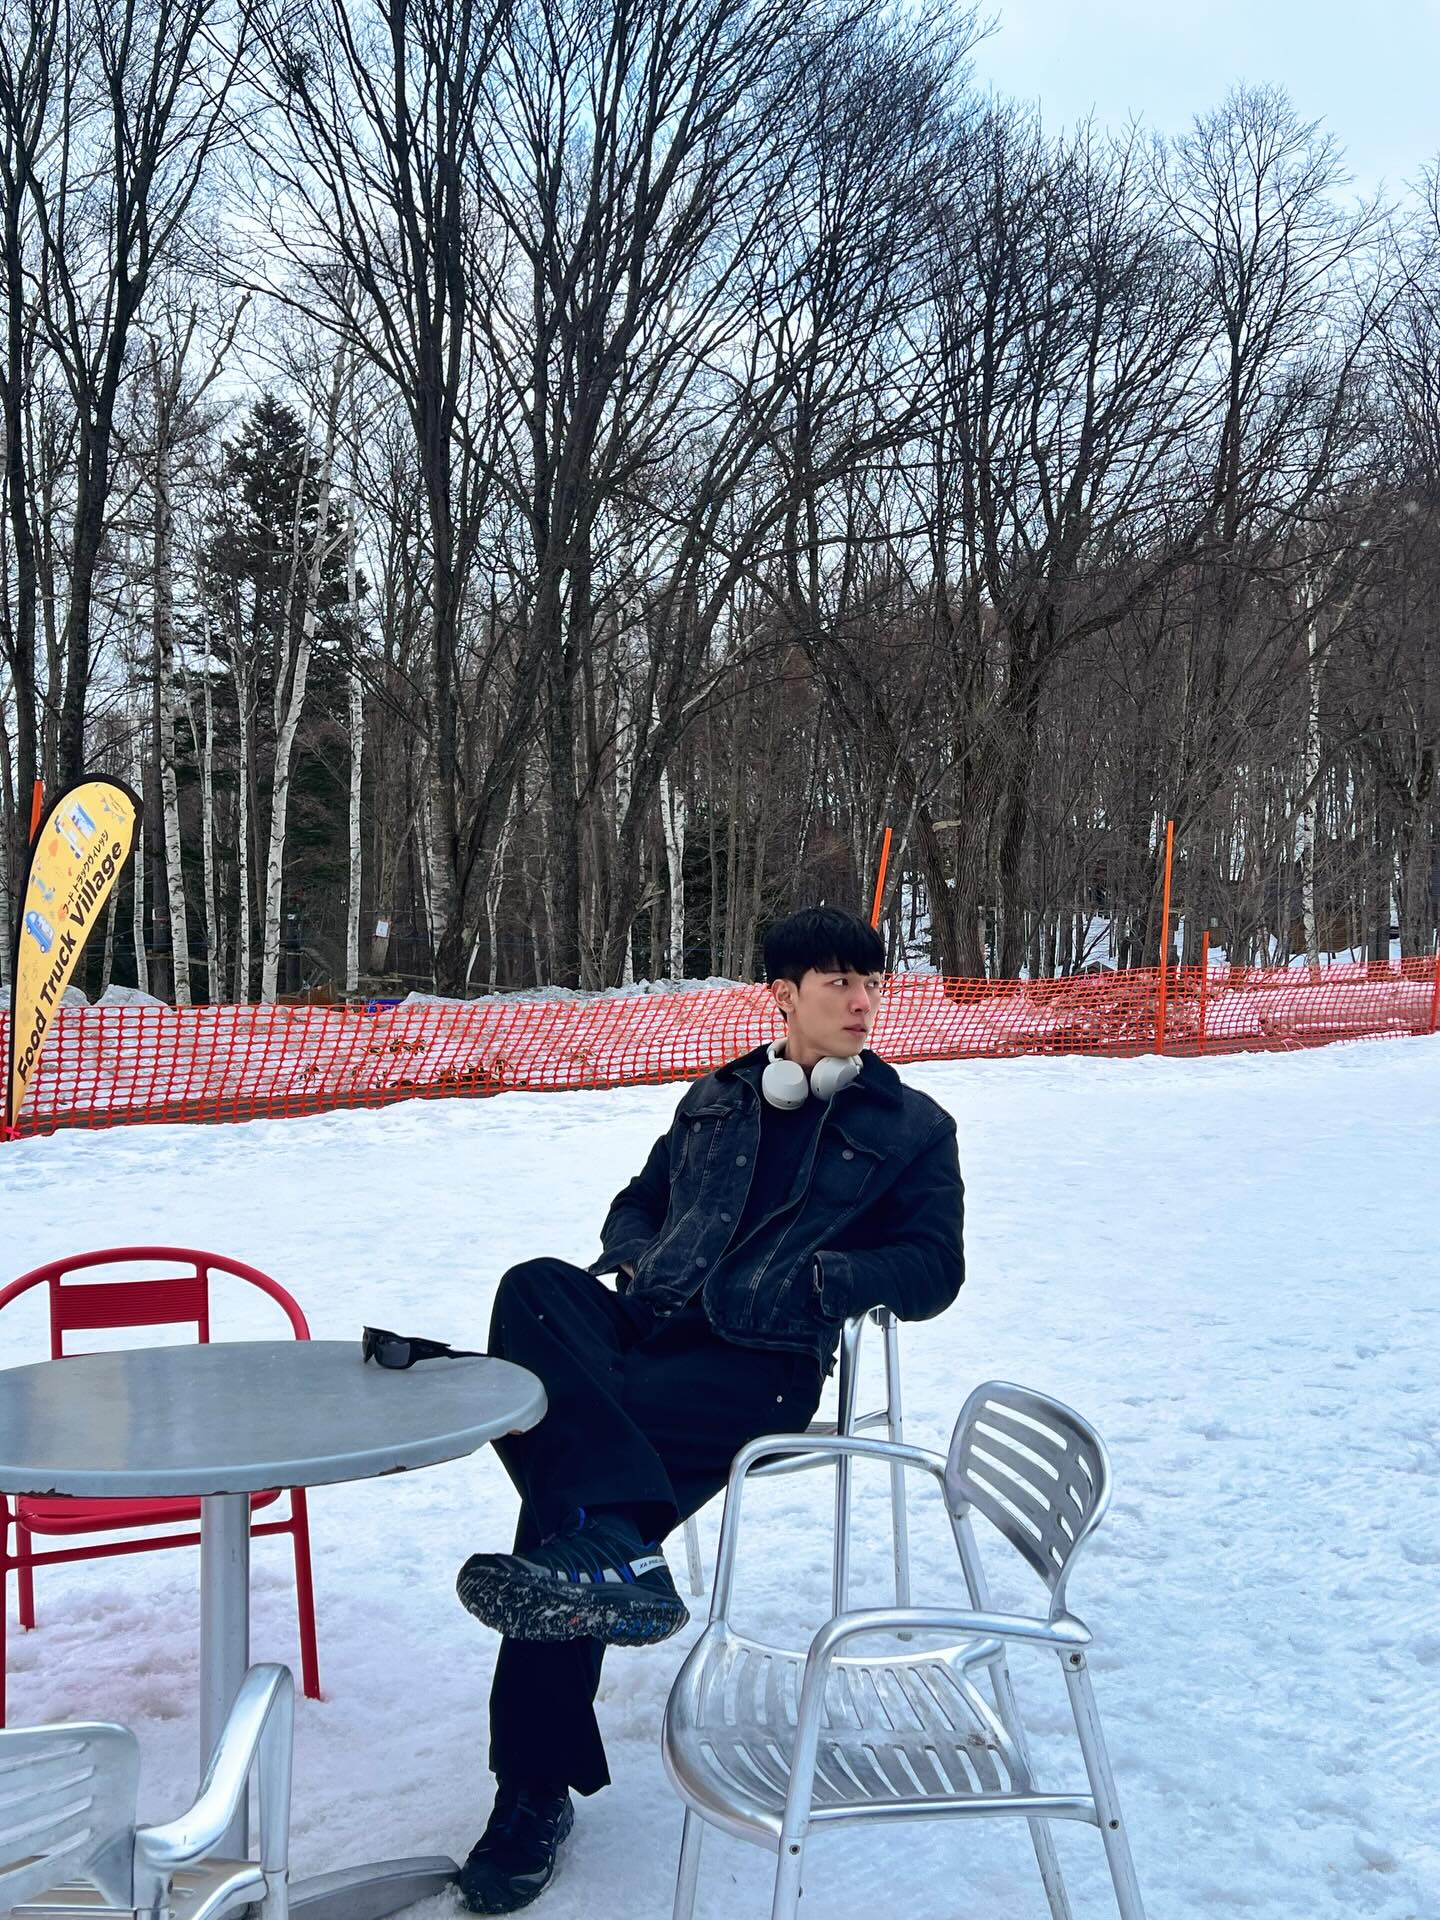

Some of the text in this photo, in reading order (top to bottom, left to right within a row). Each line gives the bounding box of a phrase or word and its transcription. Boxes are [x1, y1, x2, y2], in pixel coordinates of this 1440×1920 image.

[17, 1005, 47, 1085] Food
[40, 929, 77, 1006] Truck
[69, 842, 122, 927] Village
